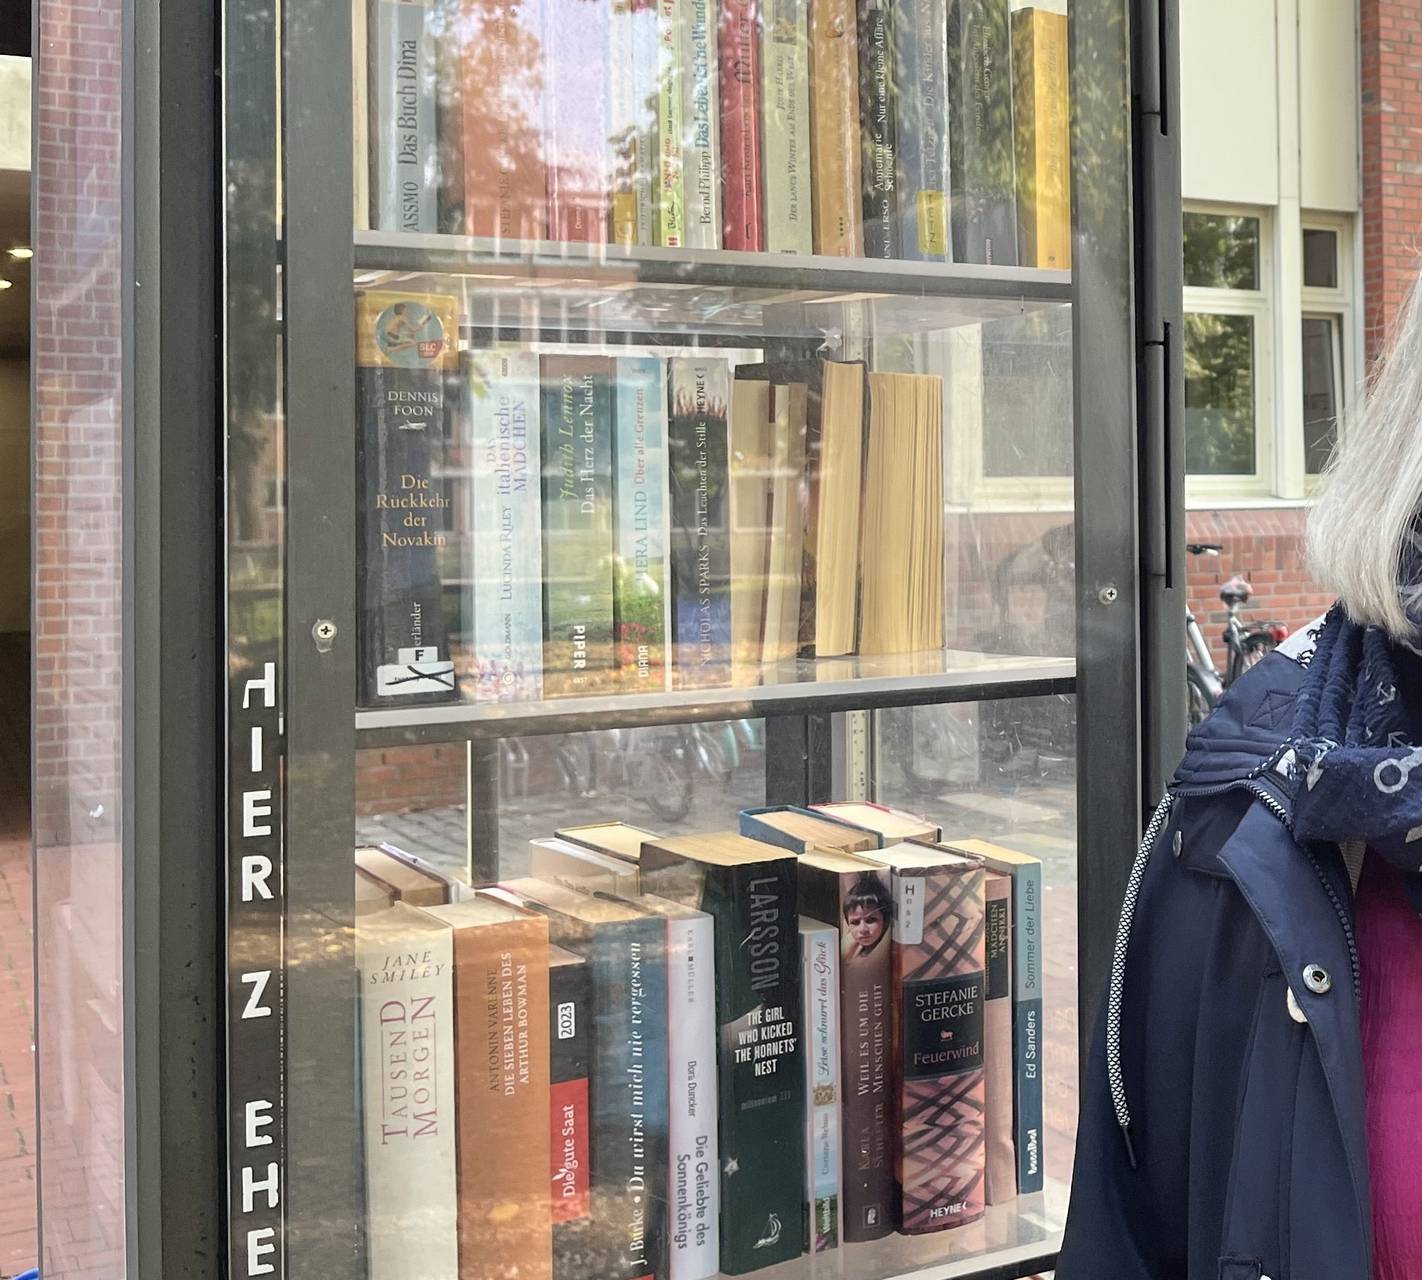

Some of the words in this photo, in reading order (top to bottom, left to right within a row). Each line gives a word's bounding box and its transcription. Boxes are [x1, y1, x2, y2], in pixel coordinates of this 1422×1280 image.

[396, 40, 417, 81] Dina
[396, 85, 417, 130] Buch
[876, 104, 887, 123] Nur
[397, 135, 417, 166] Das
[695, 123, 710, 148] Das
[698, 151, 712, 189] Philipp
[699, 191, 712, 224] Bernd
[388, 391, 438, 404] DENNIS
[394, 405, 434, 417] FOON
[558, 374, 574, 438] Lennox
[579, 375, 594, 416] Nacht
[633, 388, 645, 434] Grenzen
[696, 380, 705, 415] HEYNE
[494, 396, 511, 495] italienische
[580, 420, 594, 443] der
[695, 421, 707, 447] Stille
[558, 443, 579, 499] Judith
[581, 447, 595, 482] Herz
[695, 450, 707, 466] der
[400, 474, 429, 490] Die
[695, 469, 708, 514] Leuchten
[581, 488, 595, 513] Das
[634, 490, 648, 532] LIND
[403, 511, 427, 527] der
[499, 505, 514, 542] RILEY
[697, 516, 709, 536] Das
[499, 546, 513, 600] LUCINDA
[698, 544, 711, 594] SPARKS
[503, 613, 512, 660] GOLDMANN
[573, 625, 586, 669] PIPER
[699, 598, 712, 667] NICHOLAS
[415, 649, 424, 661] F
[638, 645, 649, 678] DIANA
[1023, 879, 1035, 912] Liebe
[750, 876, 780, 991] LARSSON
[1023, 916, 1035, 935] der
[369, 963, 446, 985] SMILEY
[382, 950, 432, 972] JANE
[500, 952, 513, 978] DES
[813, 941, 831, 976] Glück
[1024, 939, 1036, 989] Sommer
[486, 968, 499, 1029] VARENNE
[516, 964, 528, 1027] BOWMAN
[629, 942, 647, 1024] vergessen
[816, 978, 827, 997] das
[915, 985, 978, 1007] STEFANIE
[502, 980, 514, 1022] LEBEN
[747, 1010, 763, 1026] THE
[765, 1006, 784, 1023] GIRL
[857, 991, 869, 1012] DIE
[921, 1002, 974, 1022] GERCKE
[559, 1005, 573, 1036] 2023
[738, 1028, 758, 1046] WHO
[761, 1022, 793, 1041] KICKED
[816, 998, 828, 1045] schnurrt
[858, 1017, 869, 1037] UM
[1025, 1010, 1037, 1060] Sanders
[503, 1025, 515, 1070] SIEBEN
[517, 1030, 529, 1084] ARTHUR
[628, 1030, 643, 1056] nie
[735, 1047, 752, 1063] THE
[914, 1041, 980, 1065] Feuerwind
[379, 1000, 409, 1146] TAUSEND
[410, 994, 438, 1141] MORGEN
[487, 1031, 500, 1092] ANTONIN
[687, 1060, 697, 1081] Dora
[755, 1059, 778, 1077] NEST
[816, 1047, 830, 1076] Leise
[1025, 1063, 1036, 1079] Ed
[504, 1073, 515, 1097] DIE
[627, 1064, 643, 1106] mich
[687, 1082, 697, 1117] Duncker
[560, 1104, 575, 1136] Saat
[629, 1114, 644, 1158] wirst
[563, 1140, 578, 1170] gute
[695, 1135, 708, 1158] Die
[561, 1172, 576, 1197] Die
[627, 1165, 644, 1191] Du
[695, 1161, 709, 1218] Geliebte
[673, 1153, 692, 1249] Sonnenkönigs
[930, 1202, 962, 1219] HEYNE
[628, 1208, 645, 1251] Burke
[695, 1222, 710, 1246] des
[630, 1254, 648, 1266] J.
